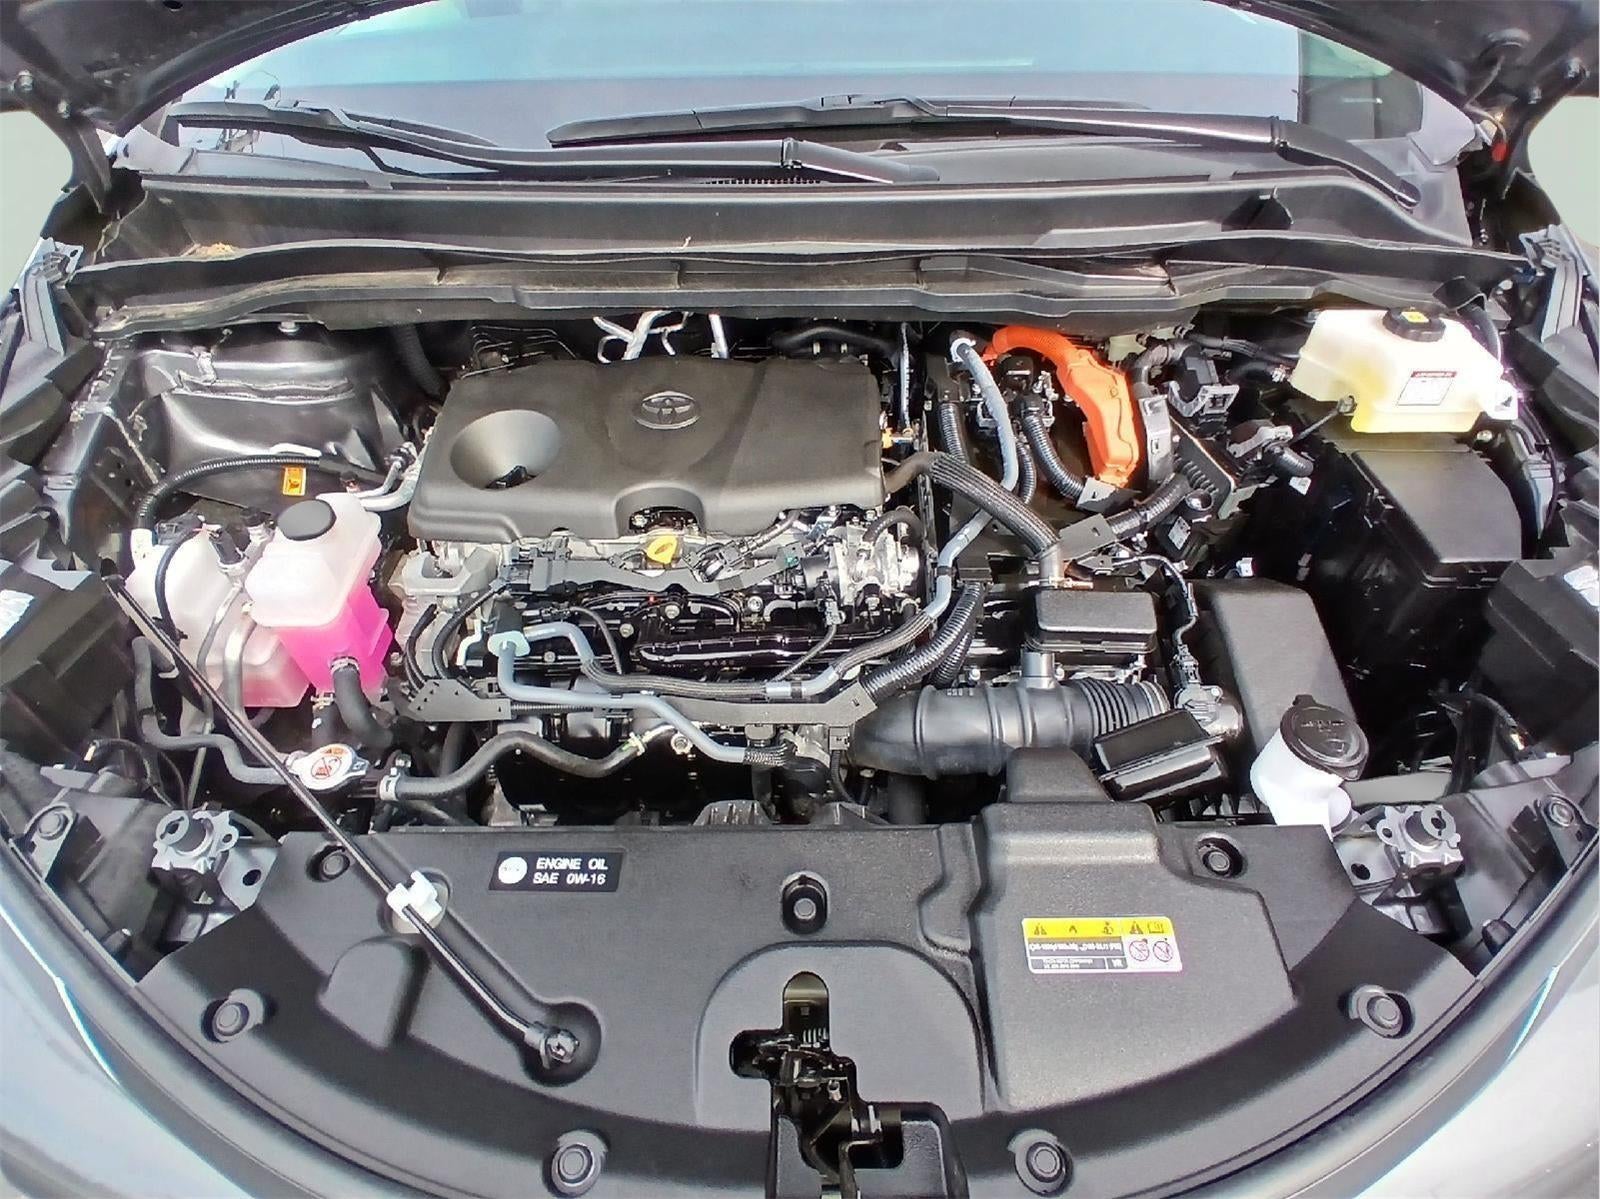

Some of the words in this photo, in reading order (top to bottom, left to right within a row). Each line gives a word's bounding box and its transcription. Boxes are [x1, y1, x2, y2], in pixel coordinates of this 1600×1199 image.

[536, 857, 582, 870] ENGINE
[588, 858, 608, 870] OIL
[532, 872, 559, 884] SAE
[566, 873, 606, 885] 0W-16
